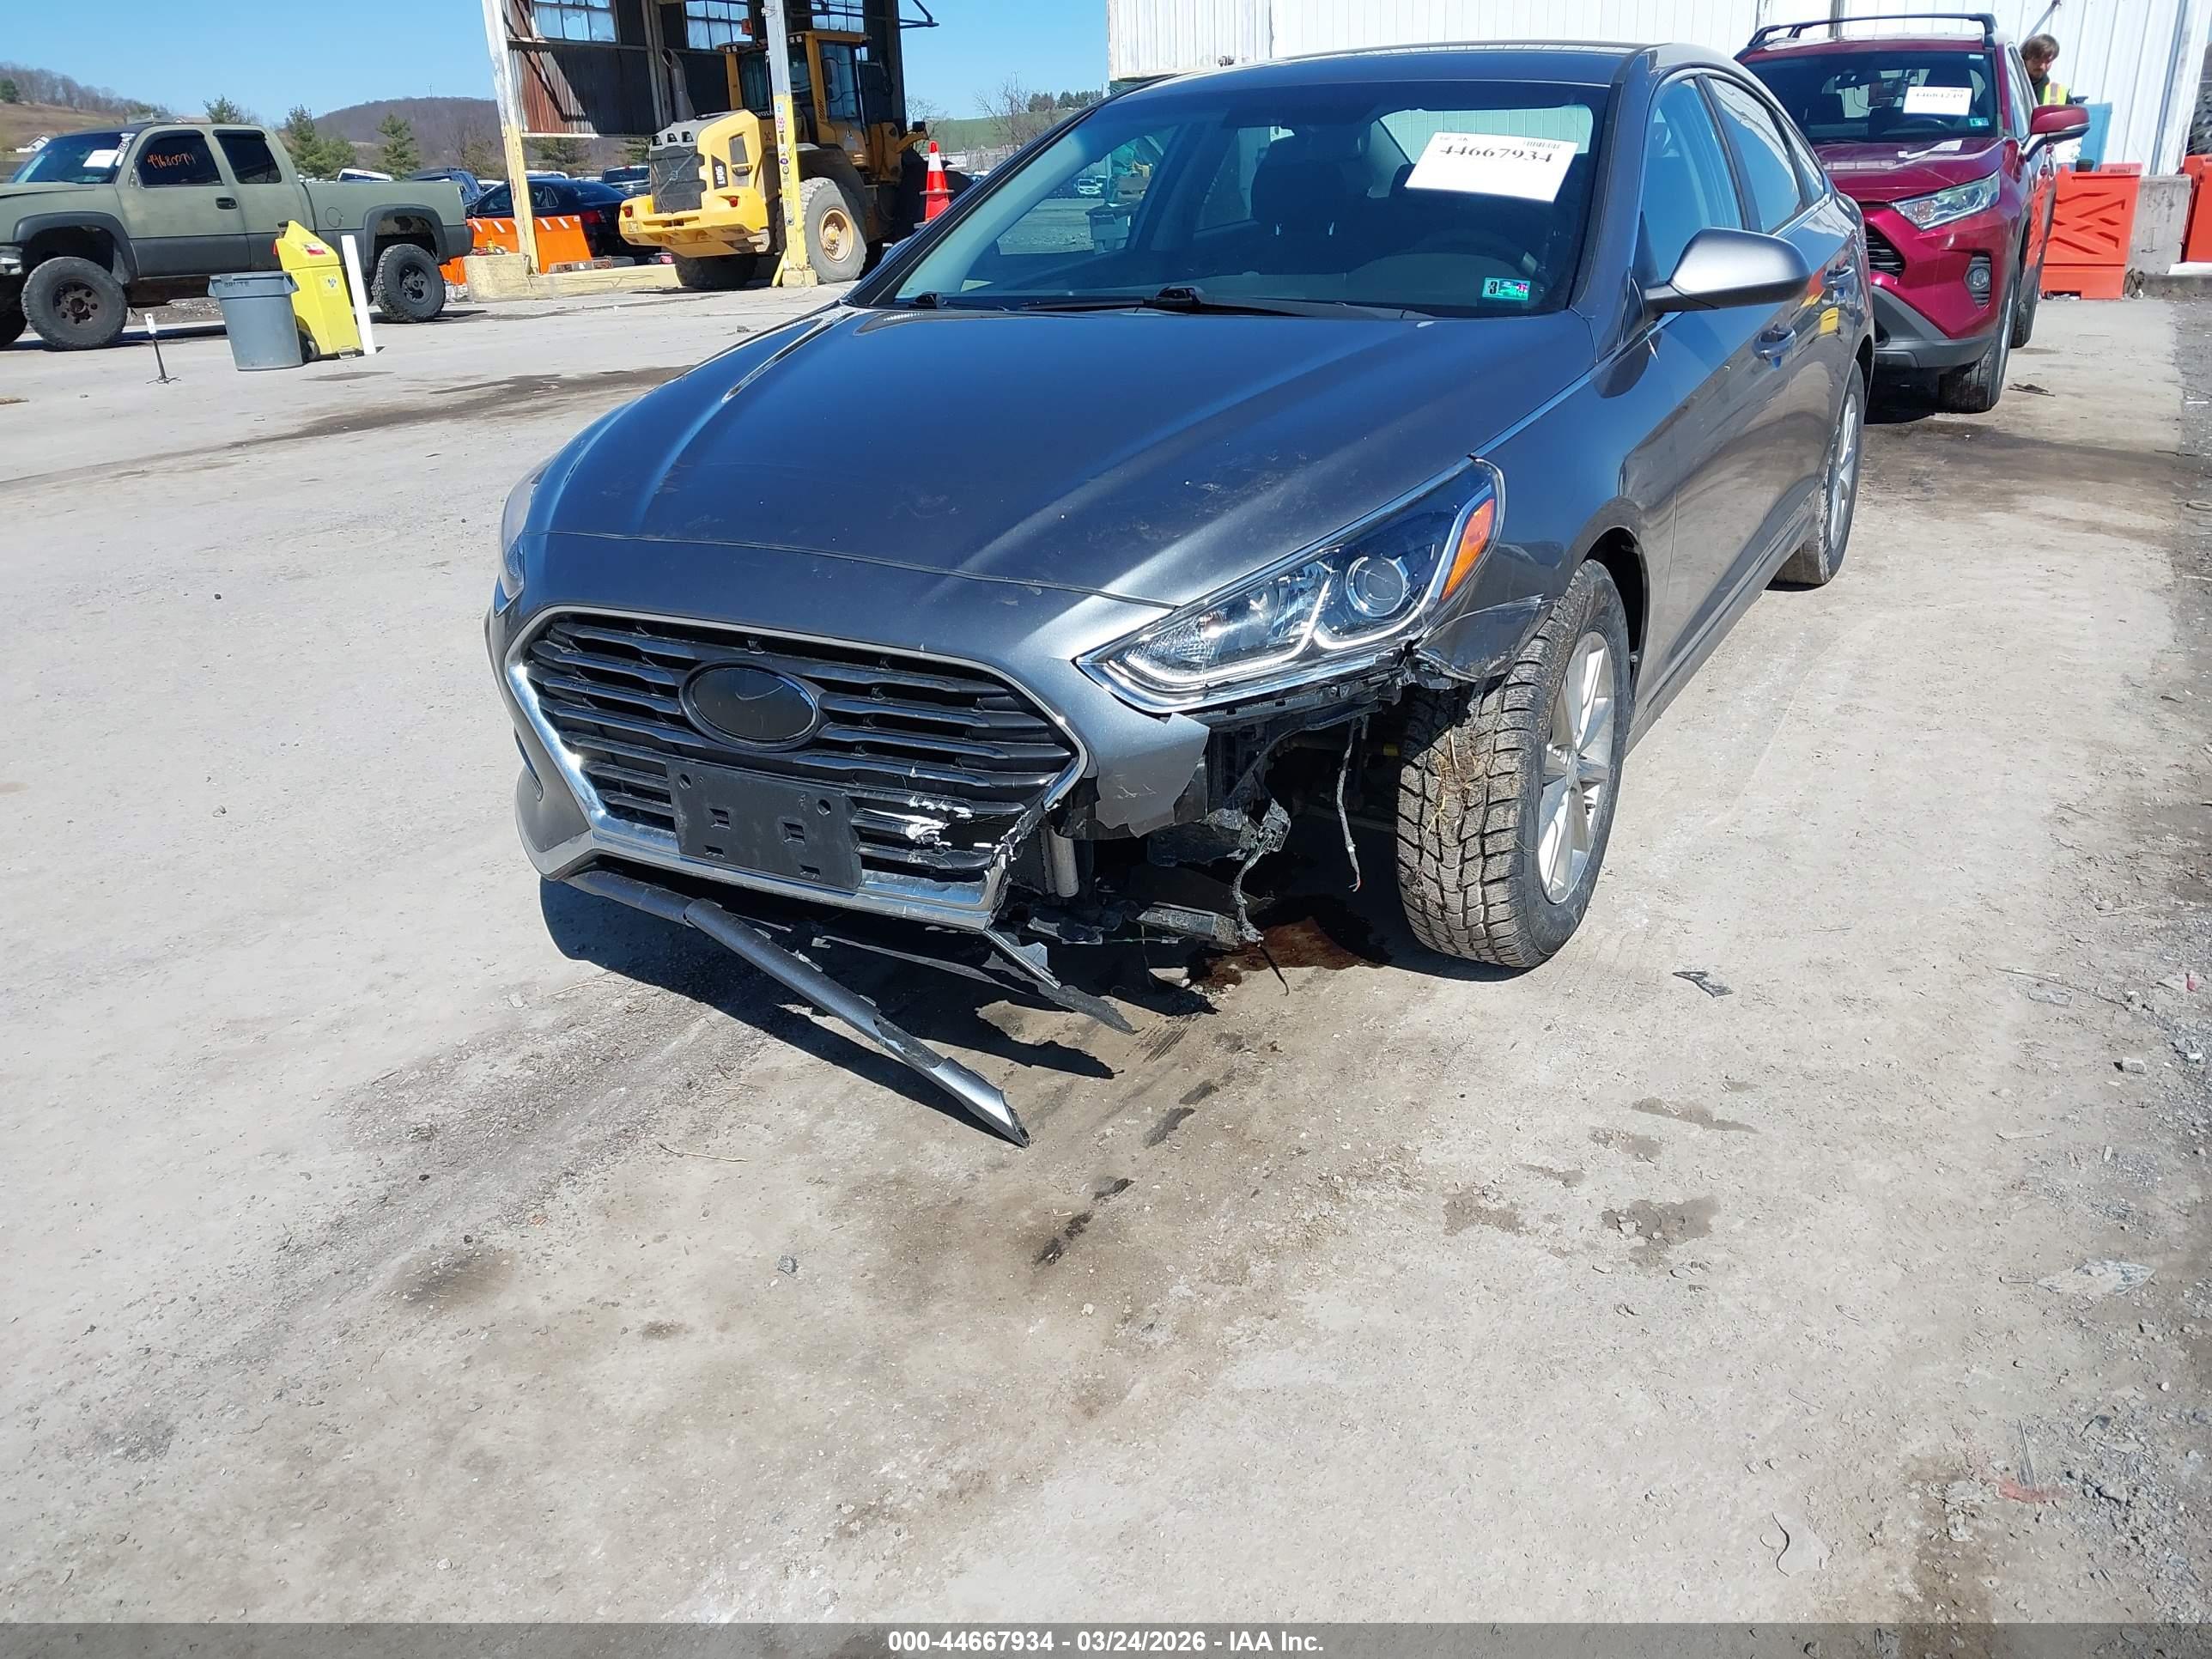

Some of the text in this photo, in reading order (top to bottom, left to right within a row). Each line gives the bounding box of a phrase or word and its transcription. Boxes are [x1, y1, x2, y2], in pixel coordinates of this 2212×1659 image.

[1440, 145, 1553, 163] 44667934
[714, 165, 726, 185] L90G
[1489, 281, 1498, 295] 3
